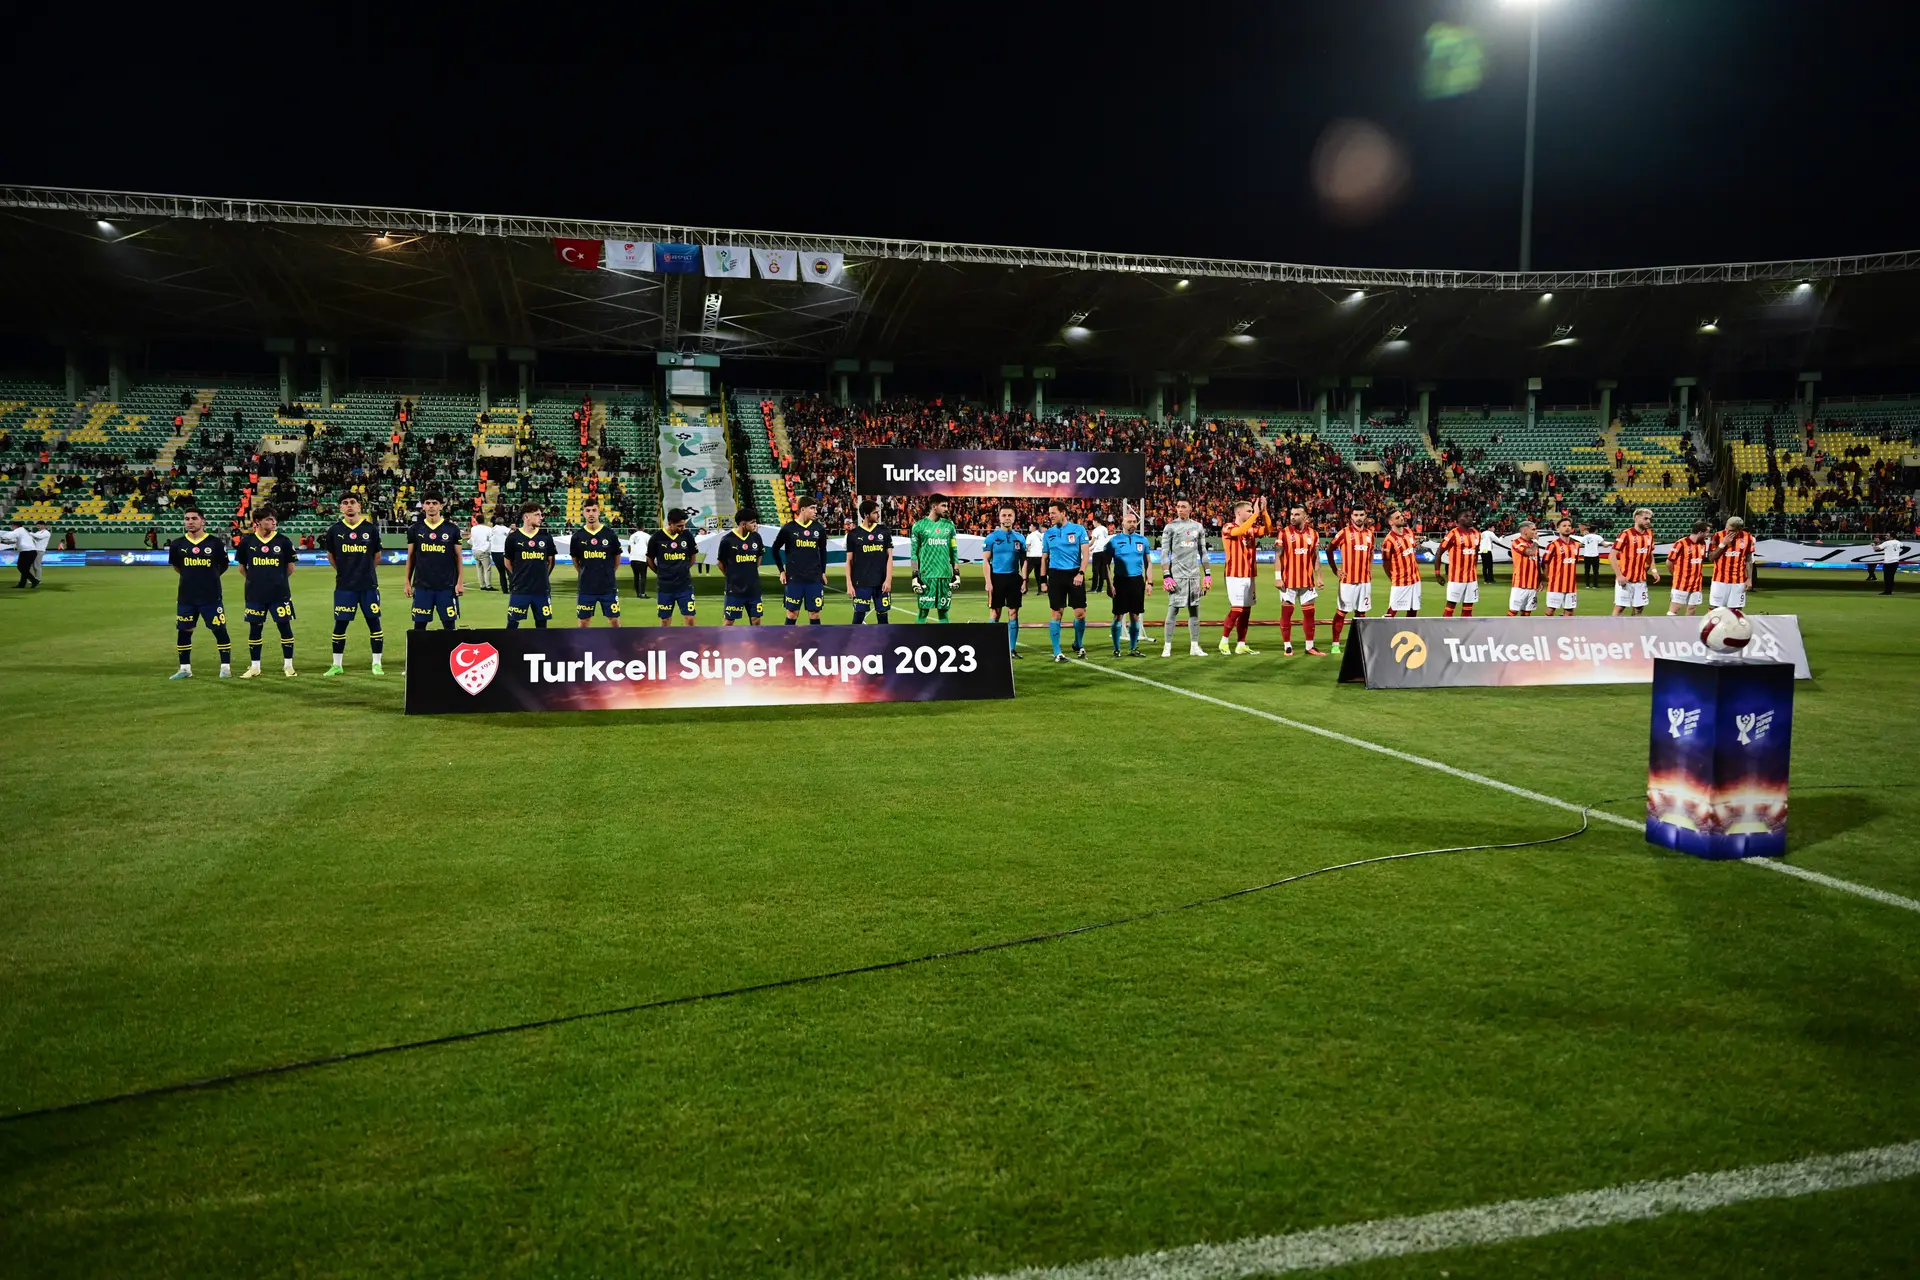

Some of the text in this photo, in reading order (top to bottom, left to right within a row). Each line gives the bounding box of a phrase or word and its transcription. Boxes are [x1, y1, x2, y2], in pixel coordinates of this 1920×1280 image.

[882, 463, 1121, 487] Turkcell Süper Kupa 2023
[421, 543, 446, 553] Otokoç
[796, 539, 816, 548] Otokoç
[342, 544, 367, 553] Otokoç
[862, 544, 884, 553] Otokoç
[522, 551, 544, 560] Otokoç
[584, 551, 607, 560] Otokoç
[664, 552, 686, 560] Otokoç
[736, 554, 757, 563] Otokoç
[184, 557, 211, 567] Otokoç
[253, 557, 279, 566] Otokoç
[941, 598, 951, 606] 97
[277, 605, 292, 617] 98
[212, 613, 226, 626] 49
[1443, 635, 1551, 663] Turkcell
[1559, 635, 1634, 665] Süper
[1742, 633, 1779, 657] 23
[523, 645, 978, 686] Turkcell Süper Kupa 2023
